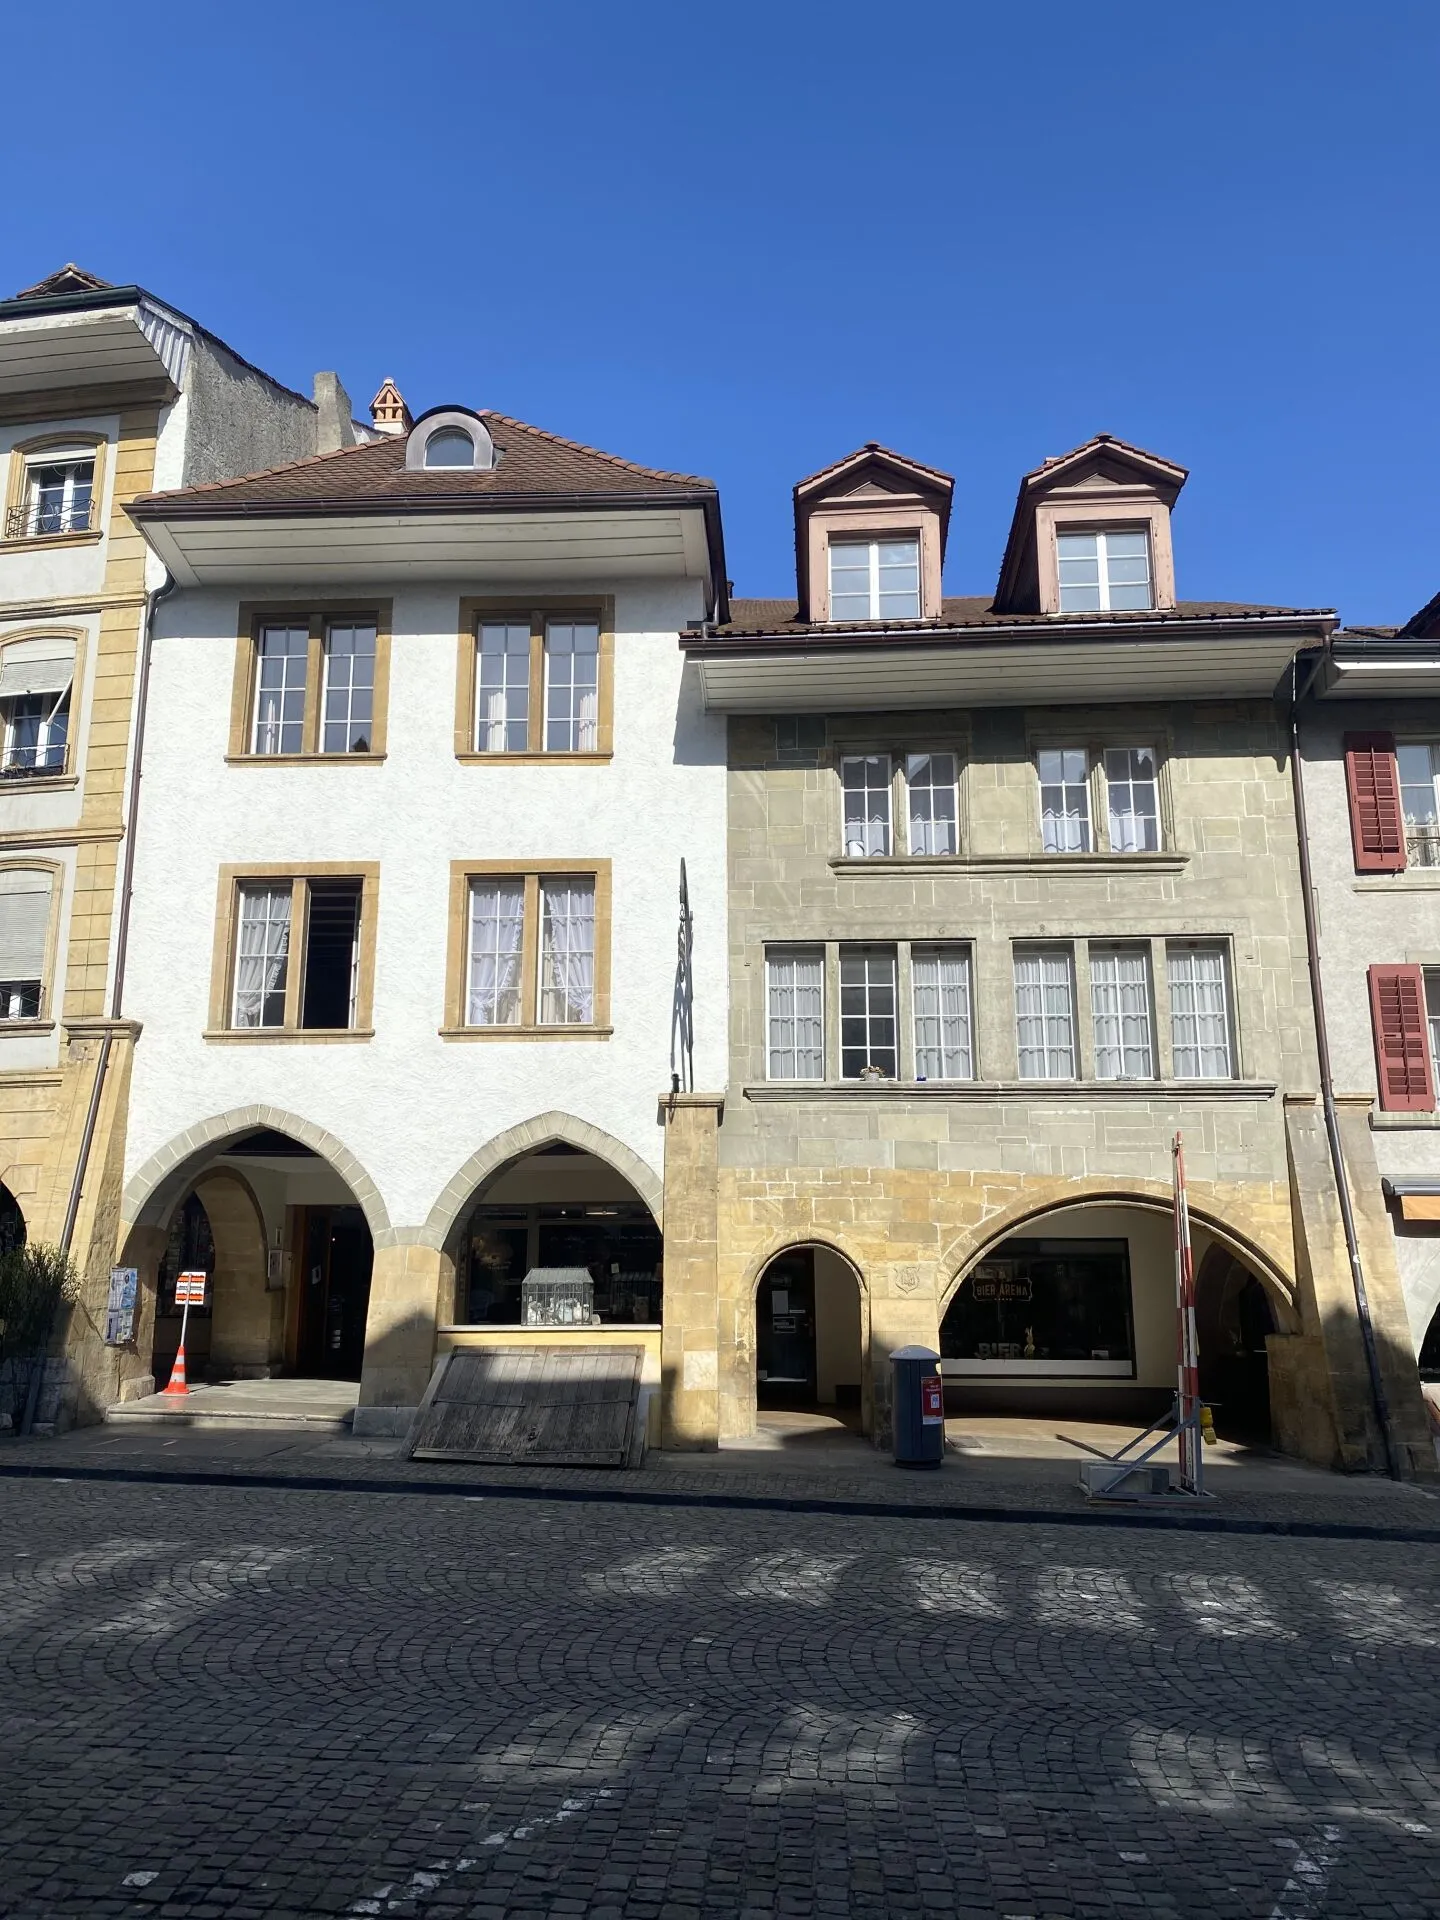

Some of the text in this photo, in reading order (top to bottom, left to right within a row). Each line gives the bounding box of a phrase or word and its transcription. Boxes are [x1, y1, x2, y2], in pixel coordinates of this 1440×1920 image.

[976, 1283, 1028, 1296] BIER ARENA
[978, 1342, 1021, 1359] BIER
